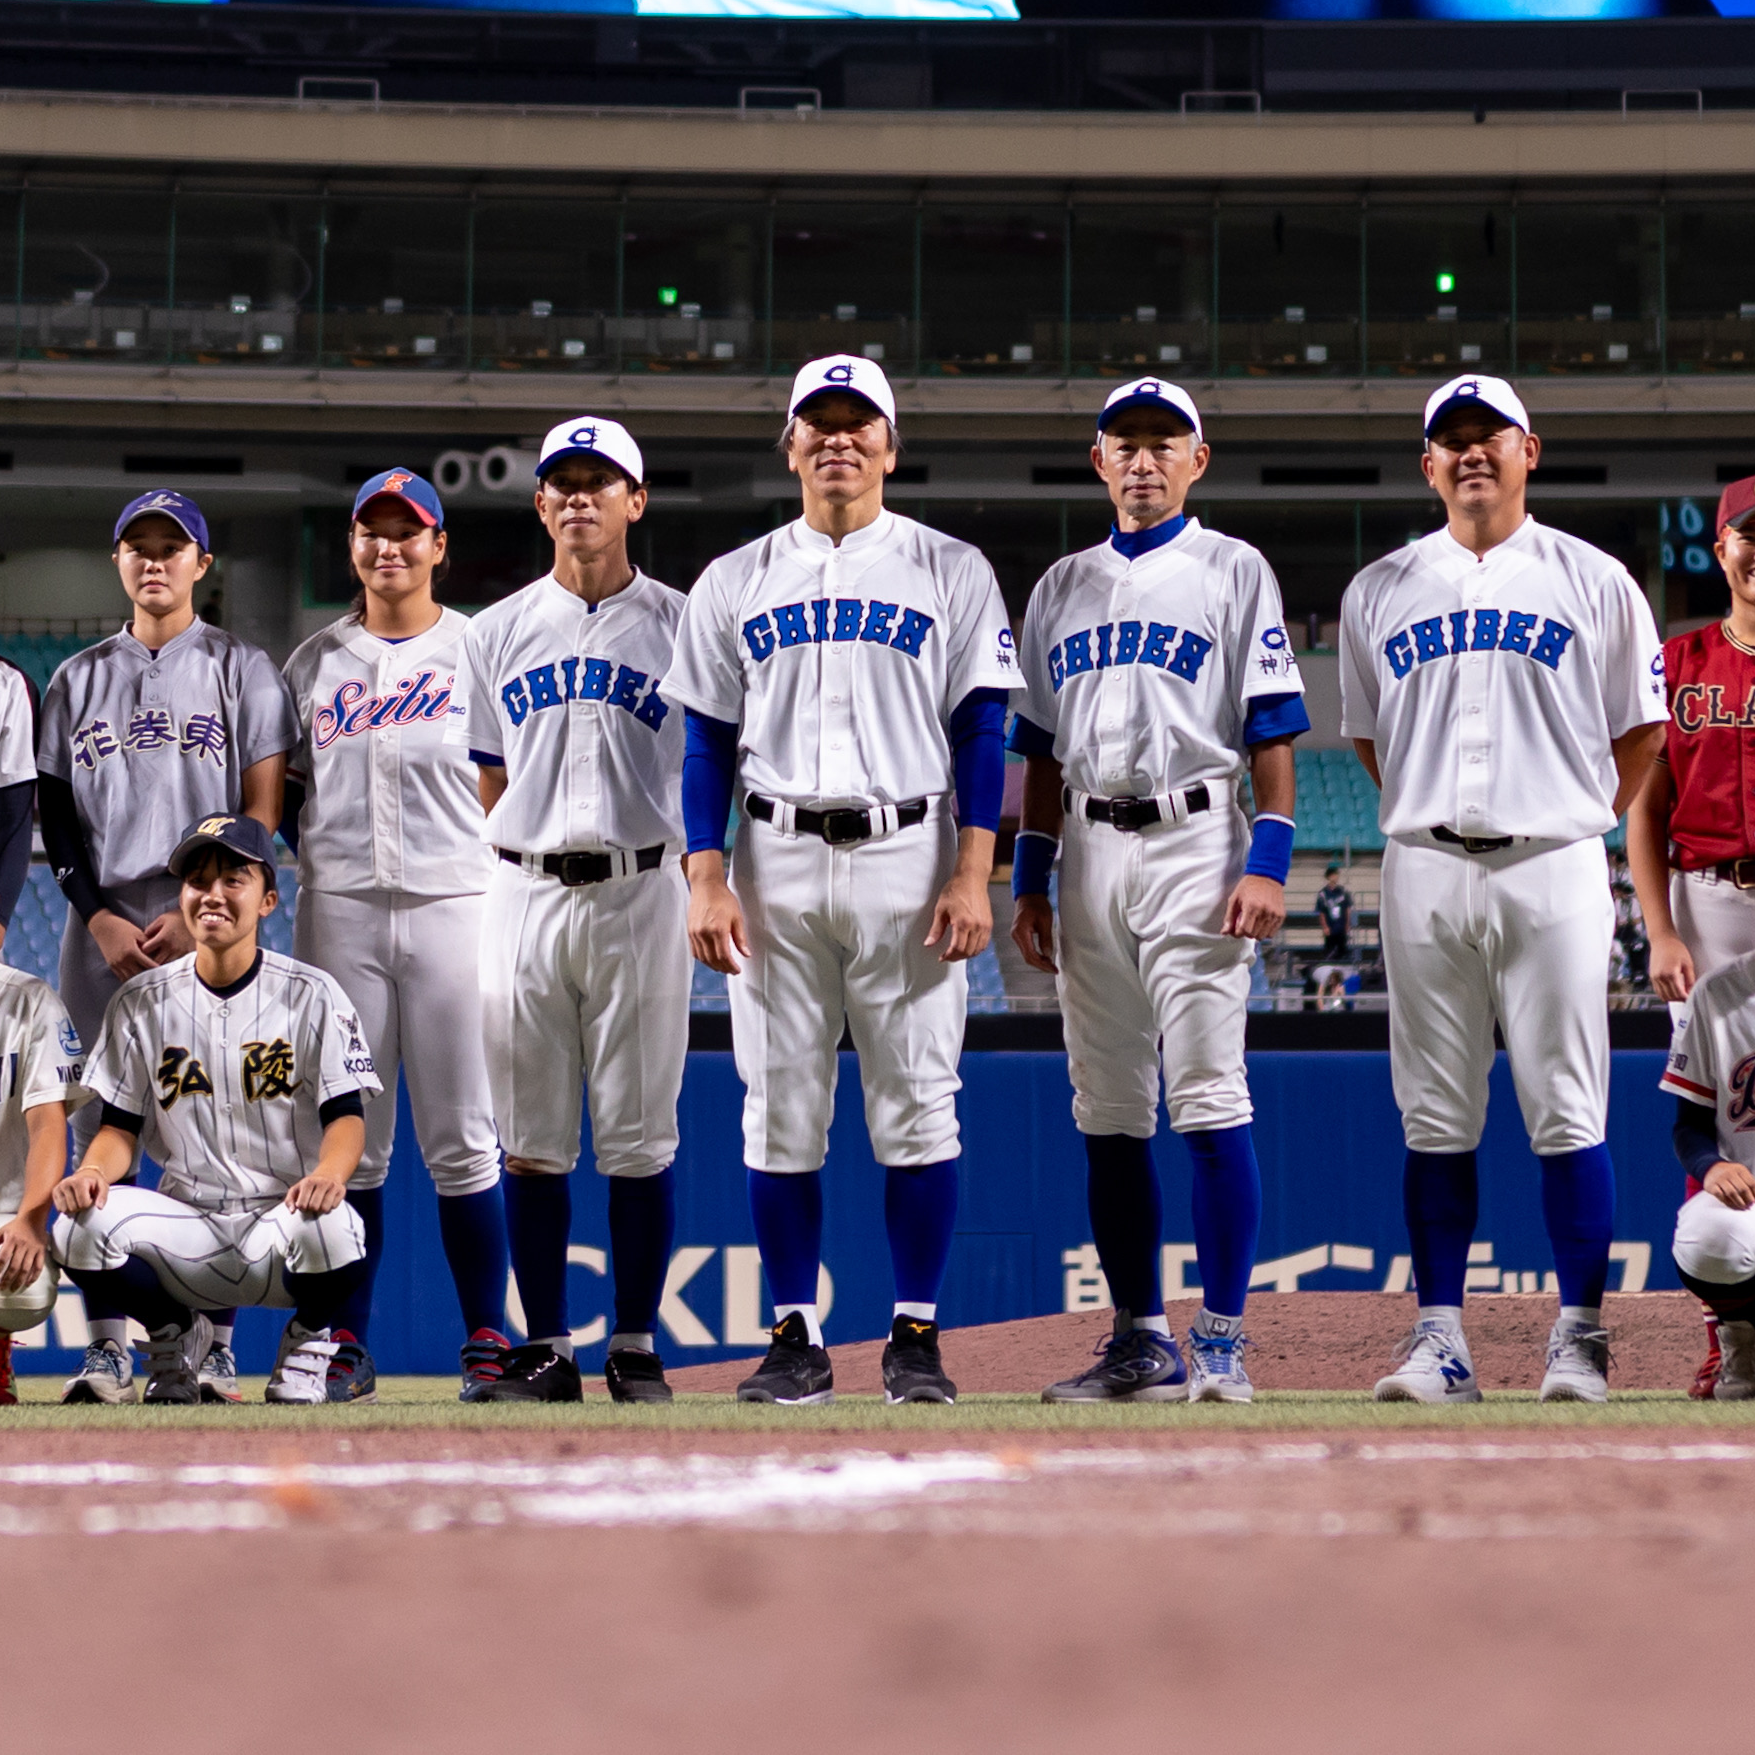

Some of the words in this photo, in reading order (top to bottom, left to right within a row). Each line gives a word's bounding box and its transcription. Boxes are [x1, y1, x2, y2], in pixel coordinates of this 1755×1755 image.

[743, 598, 935, 665] CHIBEN
[1046, 620, 1214, 694] CHIBEN
[1383, 608, 1574, 680] CHIBEN
[314, 670, 453, 751] Seibi
[501, 655, 670, 734] CHIBEN
[73, 708, 228, 769] 花巻東
